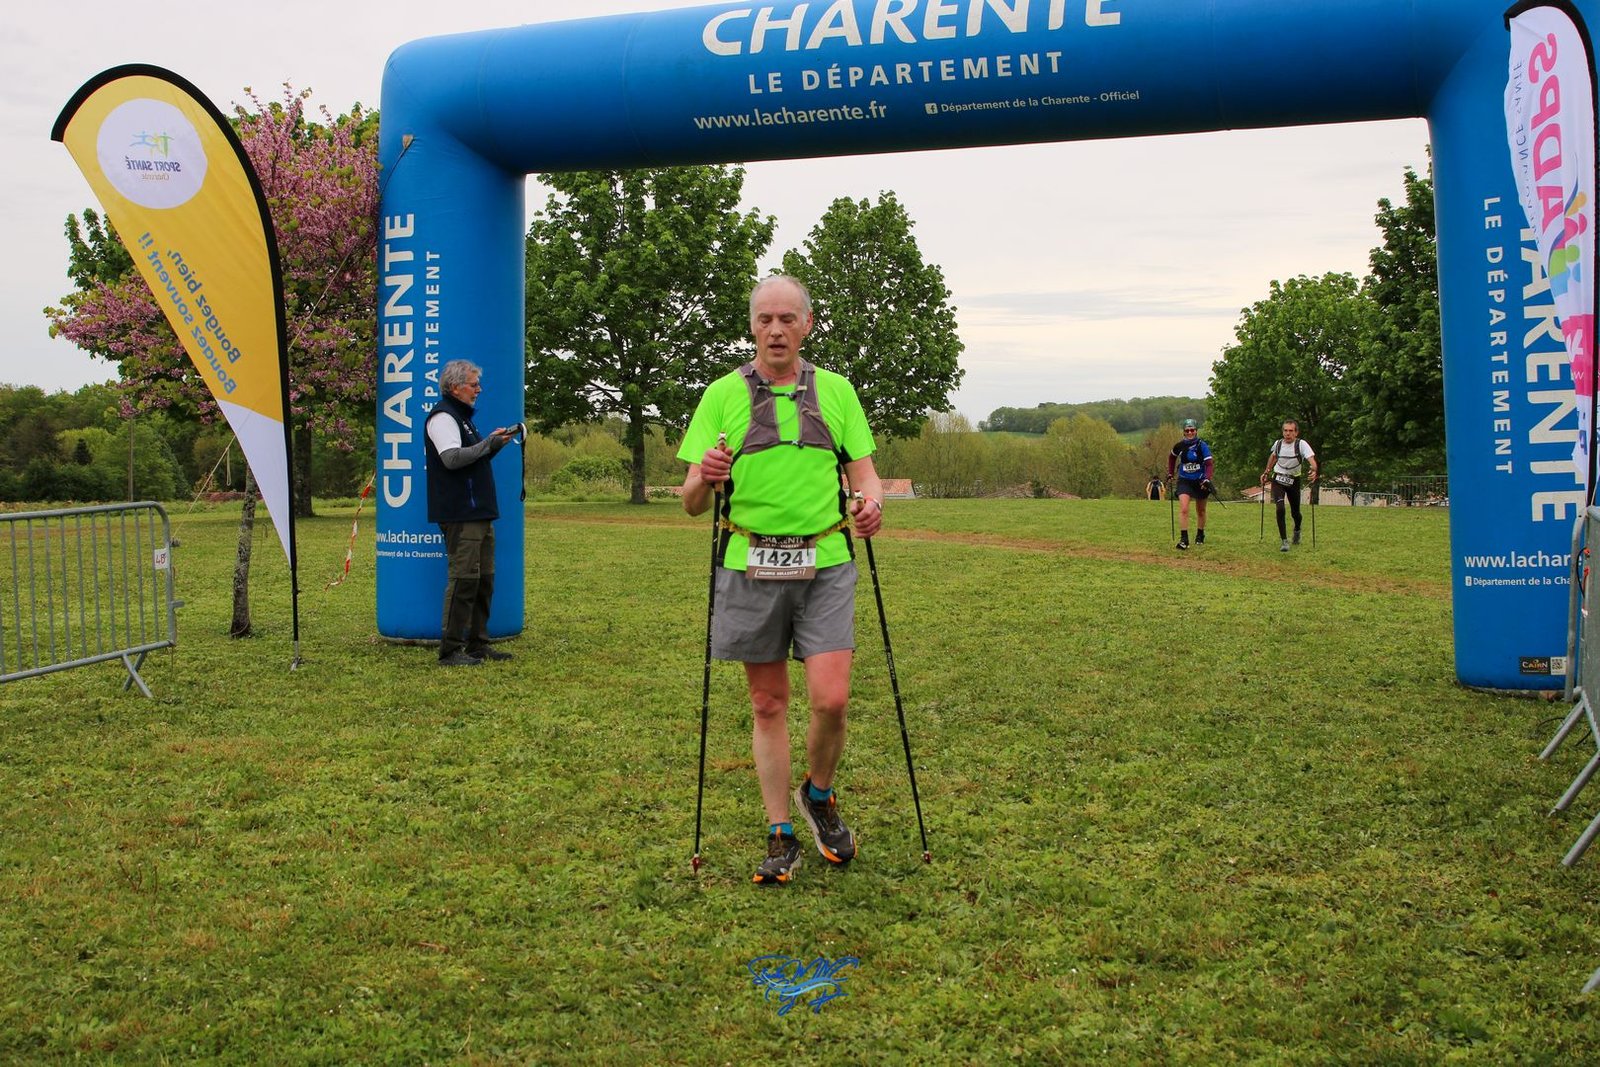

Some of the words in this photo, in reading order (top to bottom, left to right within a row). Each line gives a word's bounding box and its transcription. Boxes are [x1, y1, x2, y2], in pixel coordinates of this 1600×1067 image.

[749, 72, 783, 94] LE
[802, 51, 1062, 91] DÉPARTEMENT
[694, 100, 887, 130] www.lacharente.fr
[941, 101, 1009, 113] Département
[1013, 98, 1026, 108] de
[1028, 97, 1039, 107] la
[1041, 94, 1090, 106] Charente
[1100, 90, 1140, 102] Officiel
[1484, 197, 1502, 229] LE
[421, 251, 440, 413] ÉPARTEMENT
[383, 213, 414, 508] CHARENTE
[1486, 246, 1513, 474] DÉPARTEMENT
[1520, 227, 1587, 522] ARENTE
[756, 549, 804, 566] 1424
[1464, 550, 1581, 568] www.lachar
[1473, 577, 1525, 587] Département
[1528, 577, 1540, 586] de
[1543, 576, 1551, 585] la
